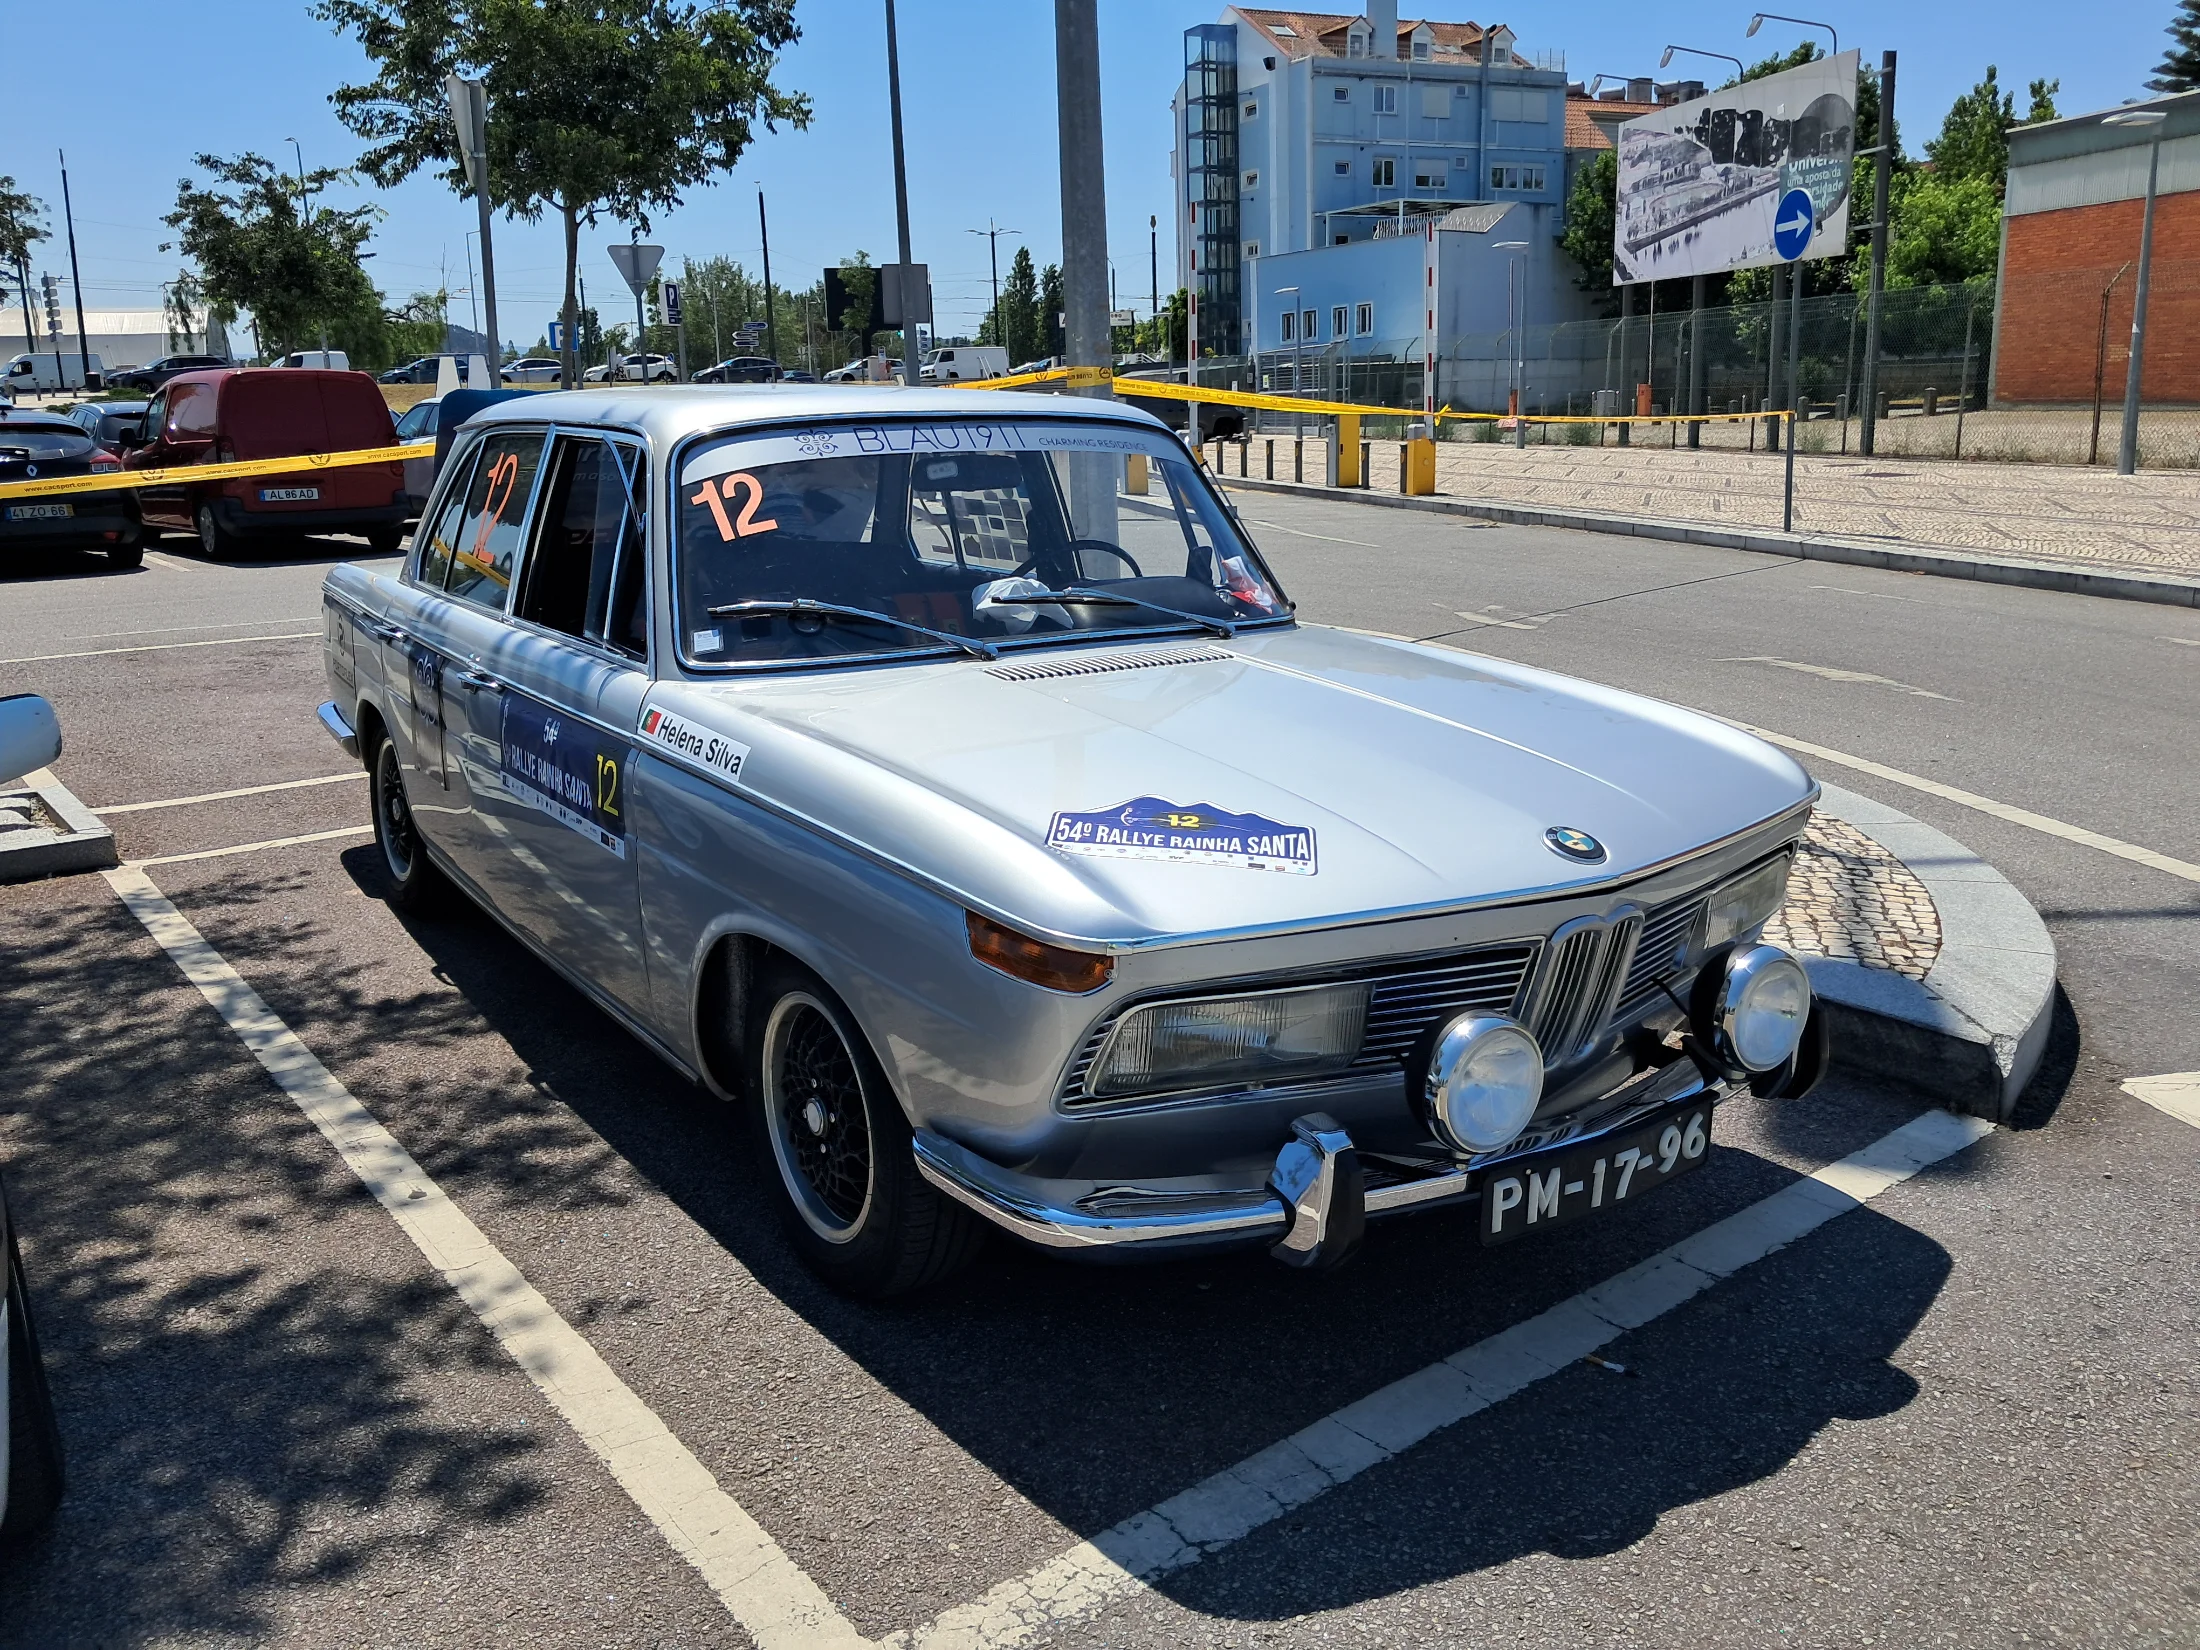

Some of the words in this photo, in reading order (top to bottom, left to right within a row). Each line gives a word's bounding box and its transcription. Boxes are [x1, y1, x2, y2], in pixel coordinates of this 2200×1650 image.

[1805, 170, 1830, 186] aposta
[1831, 165, 1841, 178] da
[667, 287, 675, 306] P
[1039, 436, 1097, 448] CHARMING
[1098, 439, 1149, 452] RESIDENCE
[24, 481, 93, 493] www.cacsport.com
[270, 490, 284, 500] AL
[285, 490, 298, 499] 86
[299, 489, 314, 499] AD
[473, 452, 518, 565] 12
[690, 472, 779, 543] 12
[658, 716, 704, 757] Helena
[705, 738, 742, 775] Silva
[511, 744, 536, 780] RALLYE
[537, 757, 564, 796] RAINHA
[564, 772, 593, 811] SANTA
[596, 754, 619, 817] 12
[1168, 814, 1200, 828] 12
[1096, 825, 1165, 847] RALLYE
[1170, 836, 1242, 853] RAINHA
[1247, 832, 1309, 860] SANTA
[1491, 1112, 1706, 1234] PM-17-96
